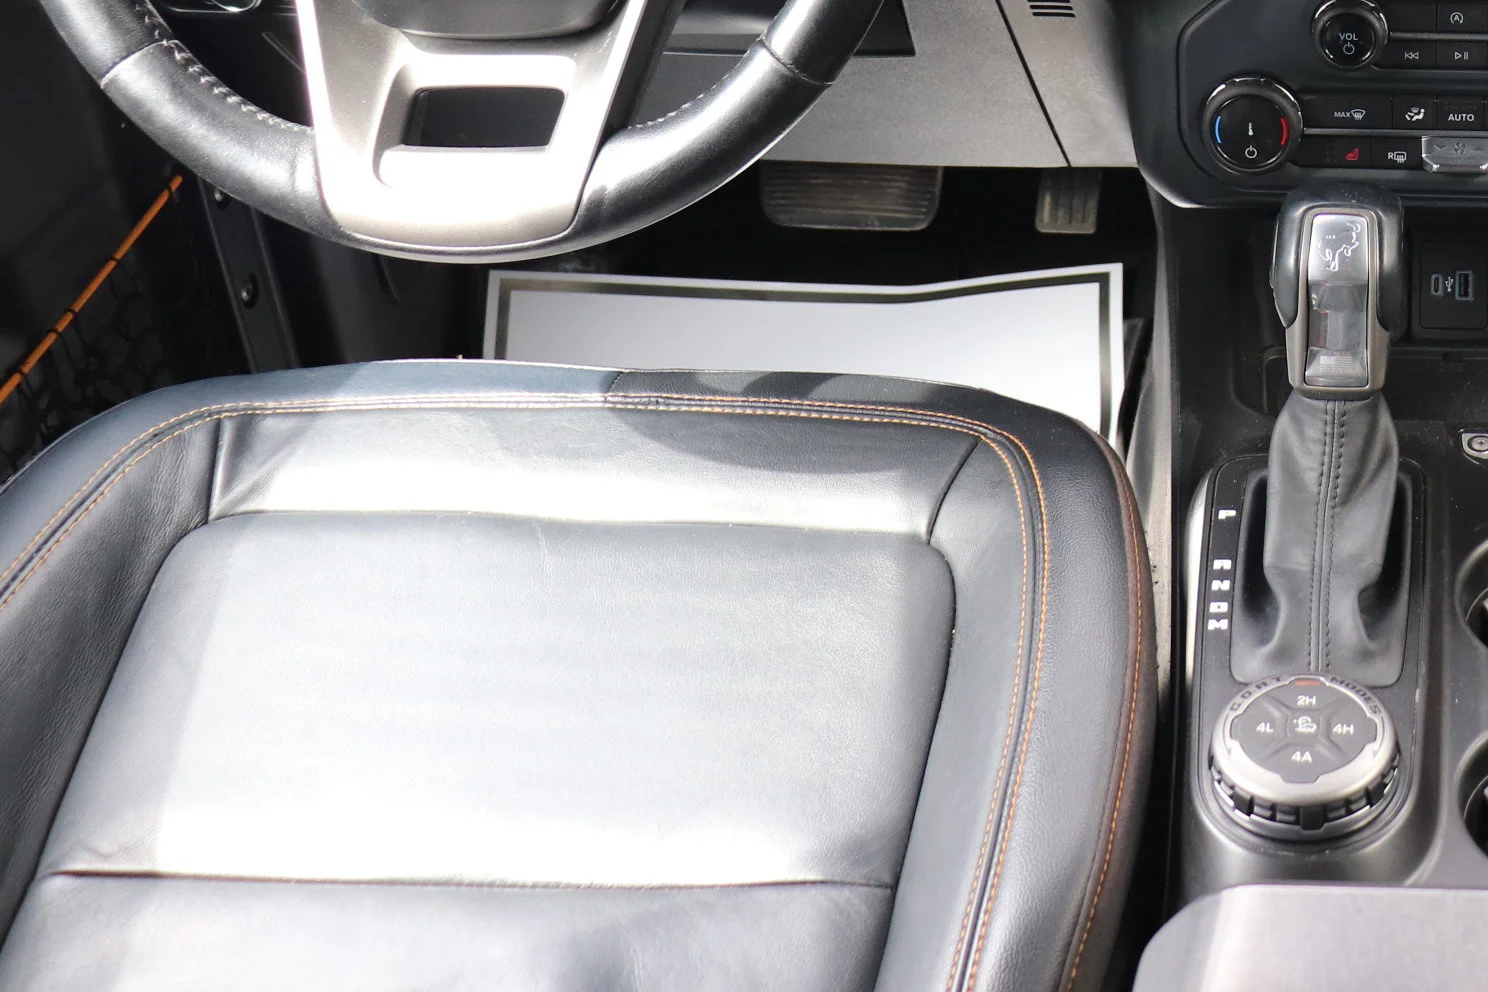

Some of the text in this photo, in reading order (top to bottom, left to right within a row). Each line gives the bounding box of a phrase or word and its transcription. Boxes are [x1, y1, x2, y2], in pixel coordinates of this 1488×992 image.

[1338, 32, 1359, 41] VOL
[1448, 113, 1475, 122] AUTO
[1387, 152, 1394, 160] R
[1218, 509, 1237, 520] P
[1212, 559, 1232, 570] R
[1211, 579, 1231, 591] N
[1209, 601, 1229, 613] D
[1207, 618, 1229, 630] M
[1296, 695, 1316, 706] 2H
[1330, 675, 1382, 715] MODES
[1255, 723, 1274, 733] 4L
[1332, 723, 1354, 734] 4H
[1291, 751, 1313, 763] 4A
